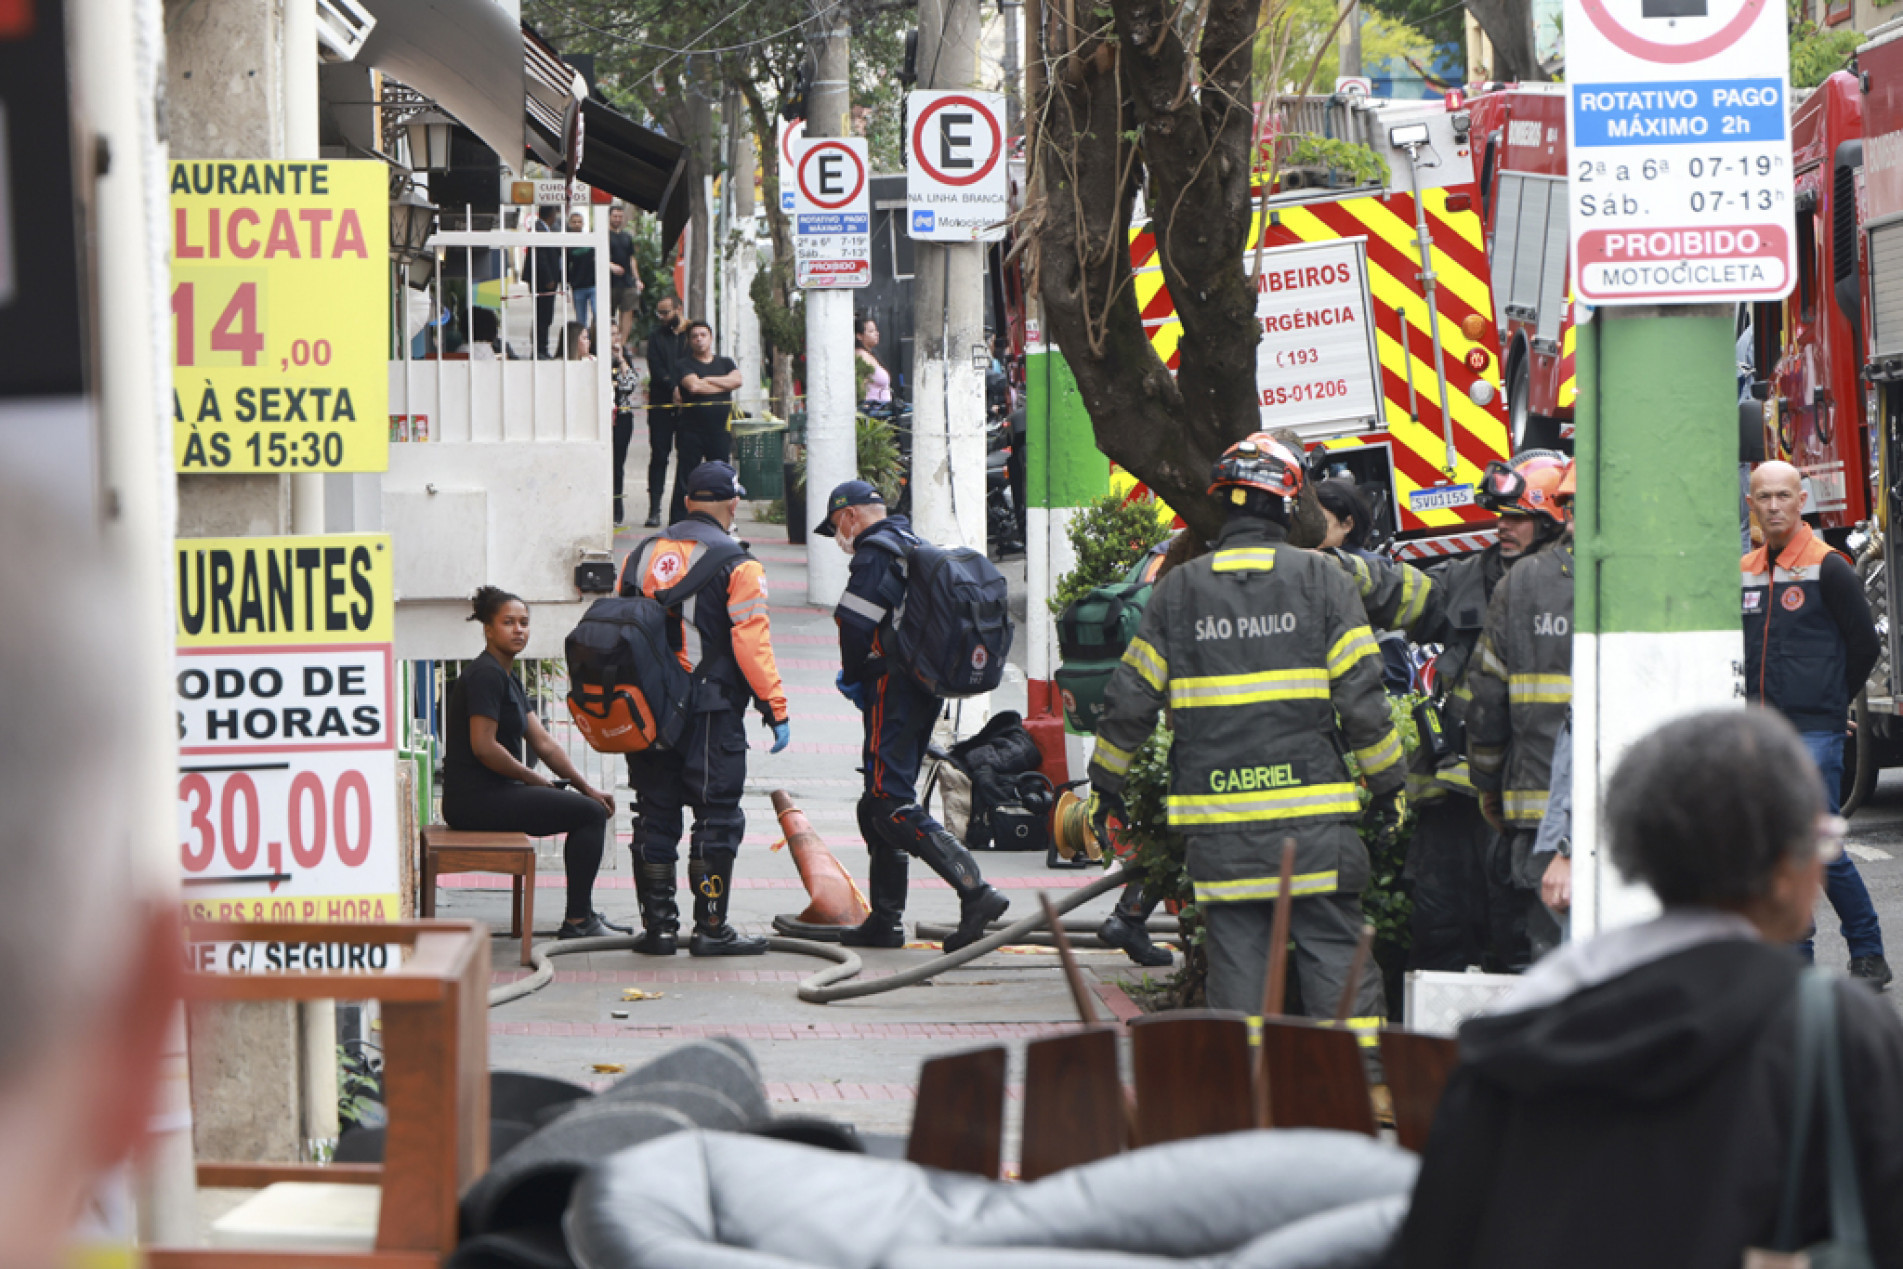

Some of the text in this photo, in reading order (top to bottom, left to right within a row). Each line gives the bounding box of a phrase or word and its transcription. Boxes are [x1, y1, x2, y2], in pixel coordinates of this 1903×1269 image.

[1580, 87, 1778, 112] ROTATIVO PAGO
[1608, 113, 1750, 138] MÁXIMO 2h
[939, 112, 975, 170] E
[171, 164, 329, 194] AURANTE
[819, 154, 844, 195] E
[1616, 165, 1630, 180] a
[927, 193, 957, 203] LINHA
[962, 193, 1004, 203] BRANCA
[175, 207, 369, 259] LICATA
[1605, 230, 1760, 257] PROIBIDO
[1602, 265, 1764, 286] MOTOCICLETA
[197, 378, 222, 422] À
[235, 387, 356, 422] SEXTA
[182, 423, 344, 467] ÀS 15:30
[1195, 612, 1296, 641] SÃO PAULO
[1534, 613, 1568, 636] SÃO
[177, 665, 366, 700] ODO DE
[207, 705, 381, 740] HORAS
[1210, 764, 1301, 792] GABRIEL
[265, 942, 388, 968] SEGURO
